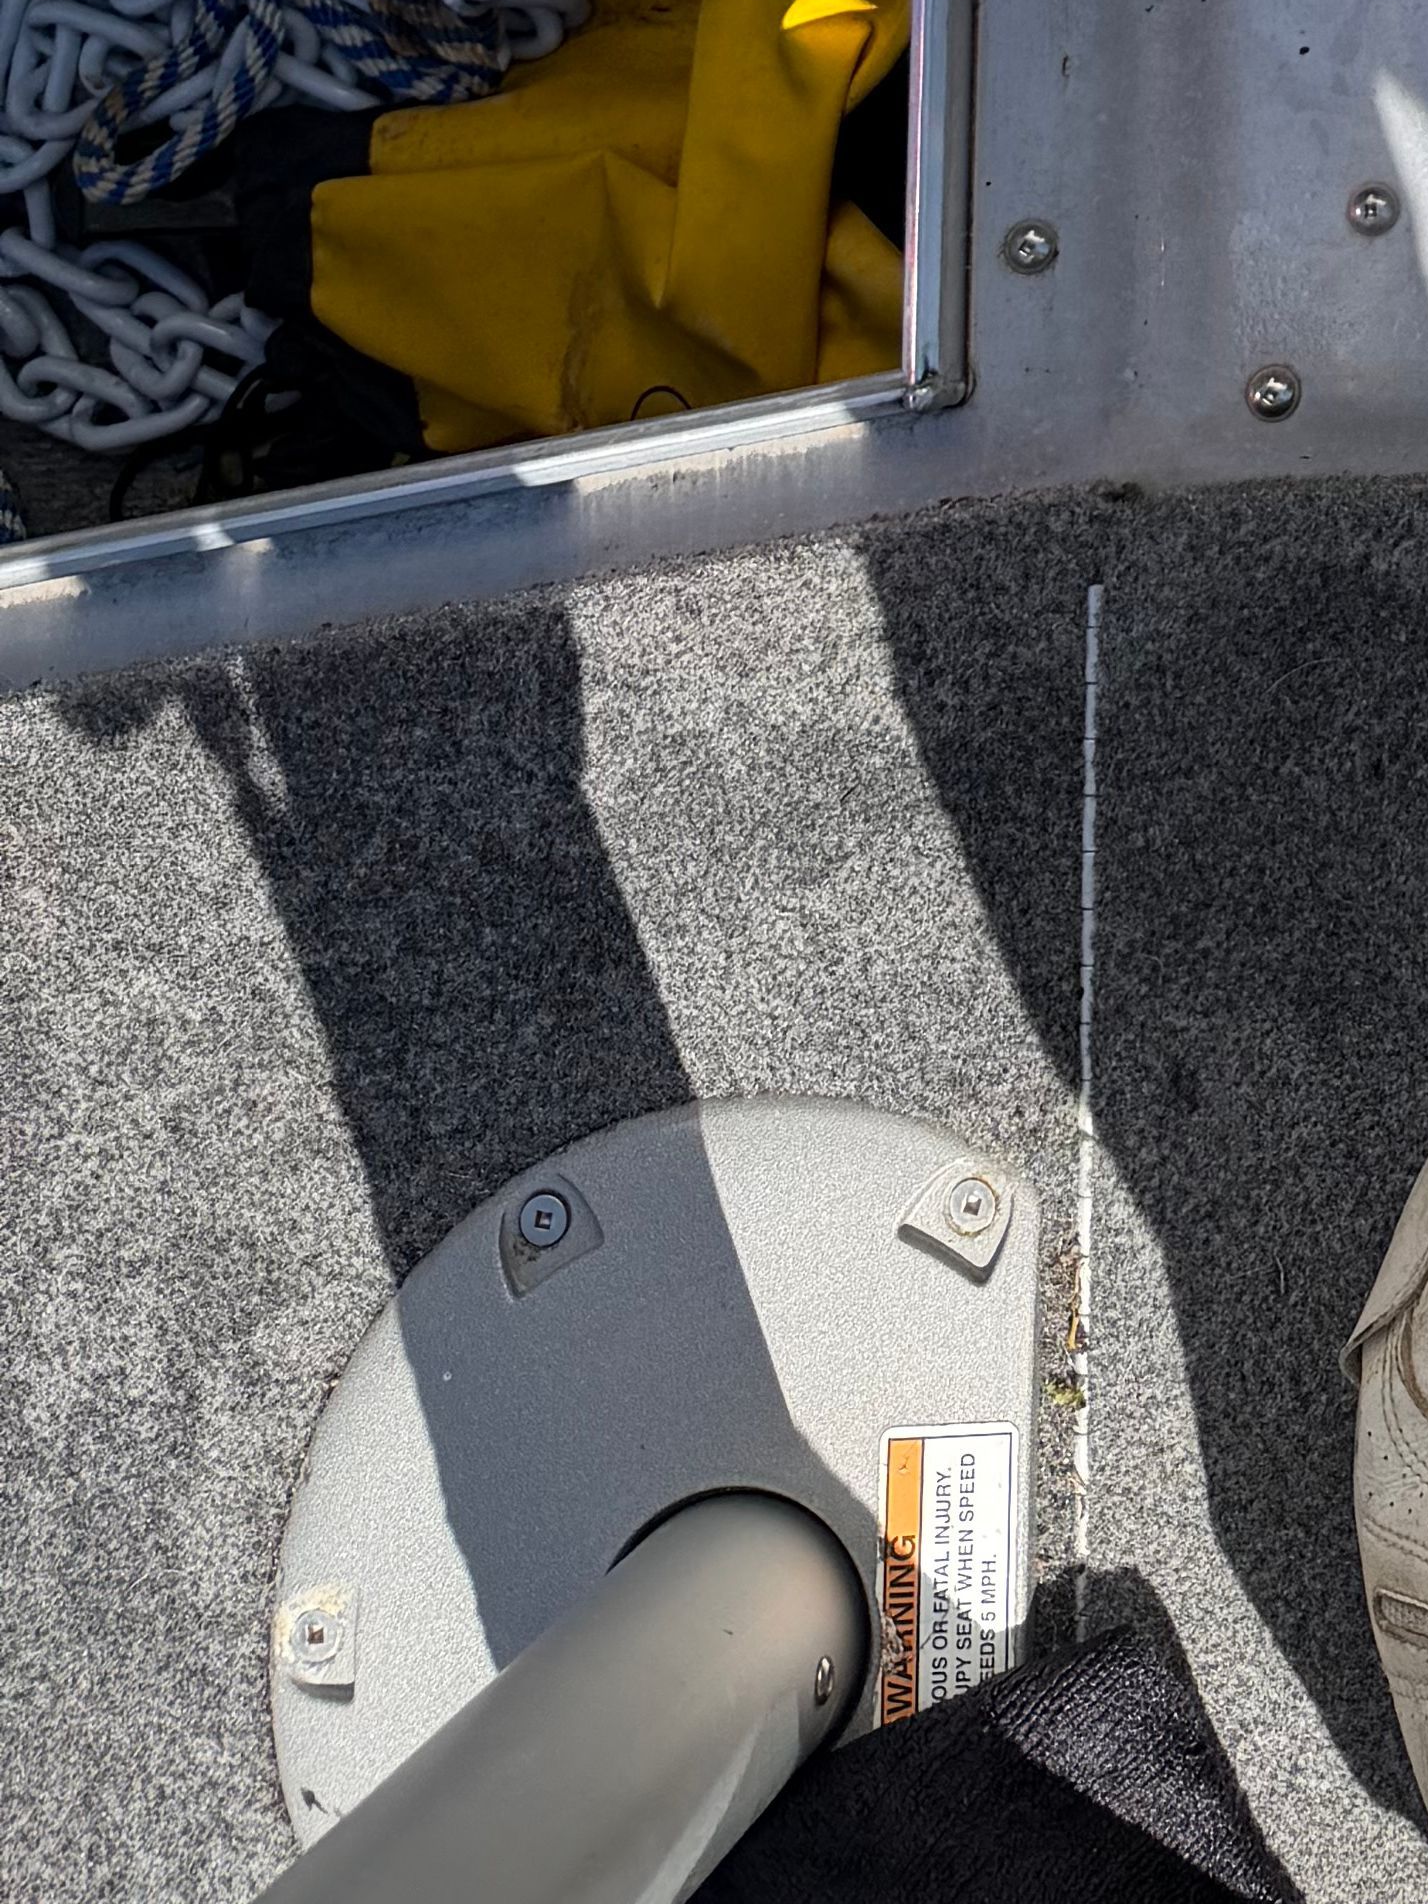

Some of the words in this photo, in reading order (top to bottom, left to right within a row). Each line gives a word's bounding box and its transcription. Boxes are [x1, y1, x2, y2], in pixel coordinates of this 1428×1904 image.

[934, 1467, 952, 1544] INJURY.
[958, 1453, 976, 1522] SPEED
[933, 1551, 950, 1615] FATAL
[957, 1529, 974, 1592] WHEN
[980, 1554, 997, 1605] MPH.
[932, 1620, 949, 1649] OR
[956, 1598, 973, 1650] SEAT
[981, 1611, 996, 1622] 5
[932, 1657, 948, 1703] OUS
[955, 1657, 971, 1699] UPY
[980, 1628, 995, 1683] EEDS
